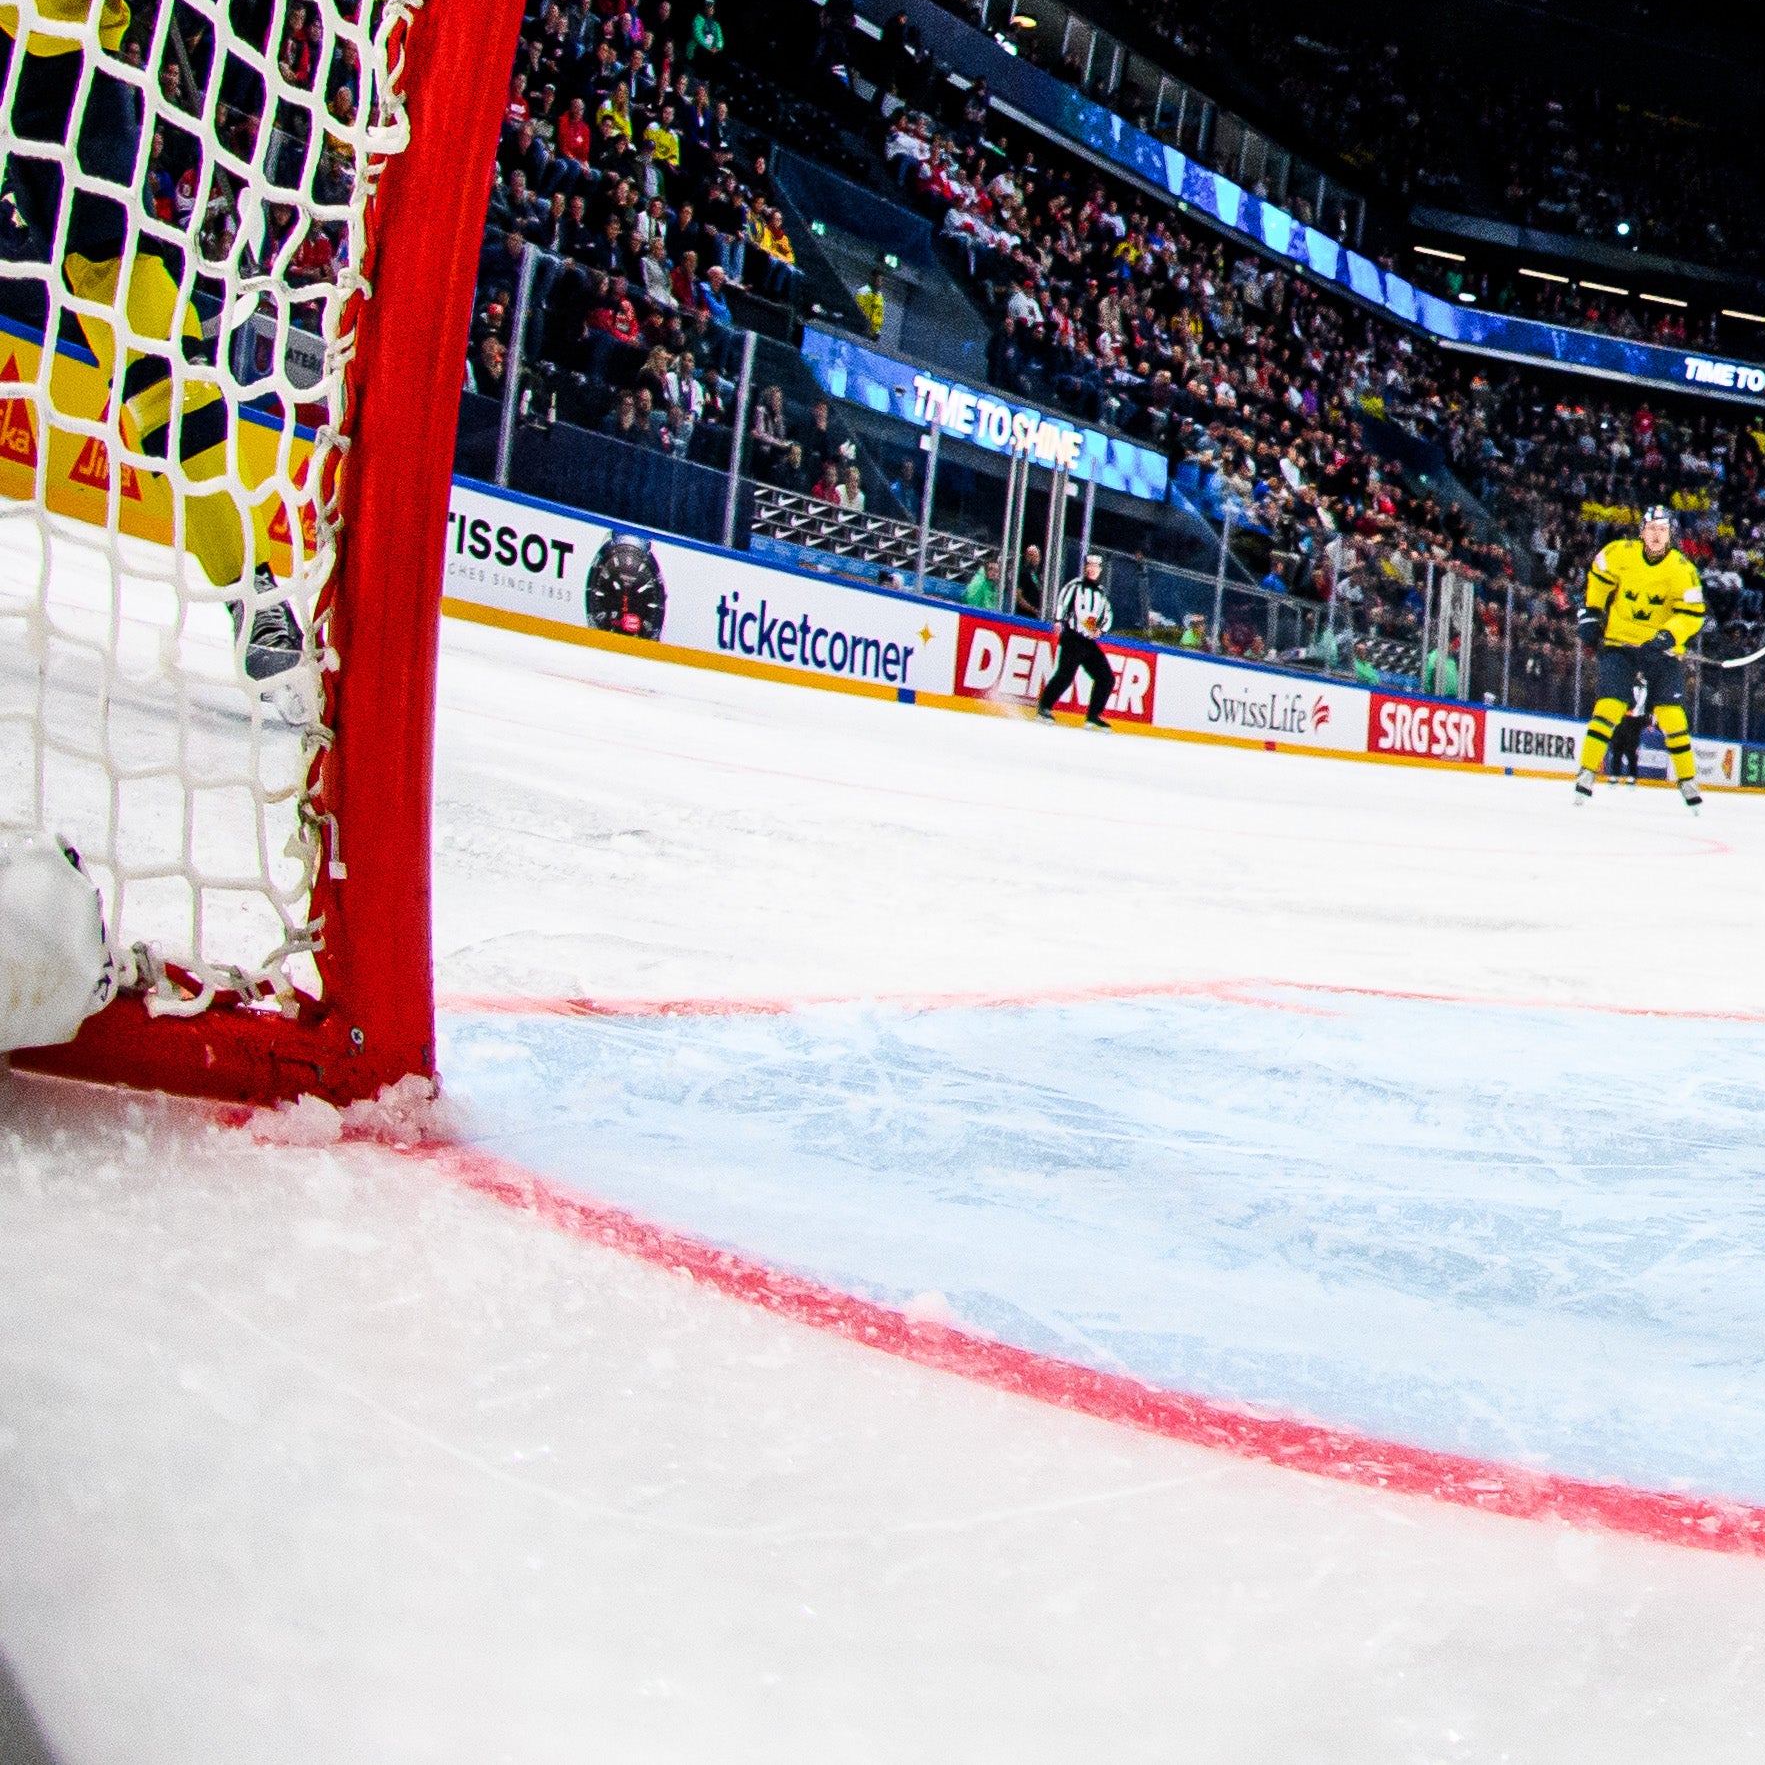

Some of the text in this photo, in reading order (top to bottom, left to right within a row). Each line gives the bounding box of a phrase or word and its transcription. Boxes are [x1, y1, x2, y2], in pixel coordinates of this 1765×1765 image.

[1684, 356, 1737, 387] TIME
[913, 373, 1084, 470] TIME TO SHINE
[447, 511, 575, 579] ISSOT
[716, 591, 914, 684] ticketcorner
[1377, 701, 1476, 759] SRG SSR
[1500, 726, 1576, 761] LIEBHERR
